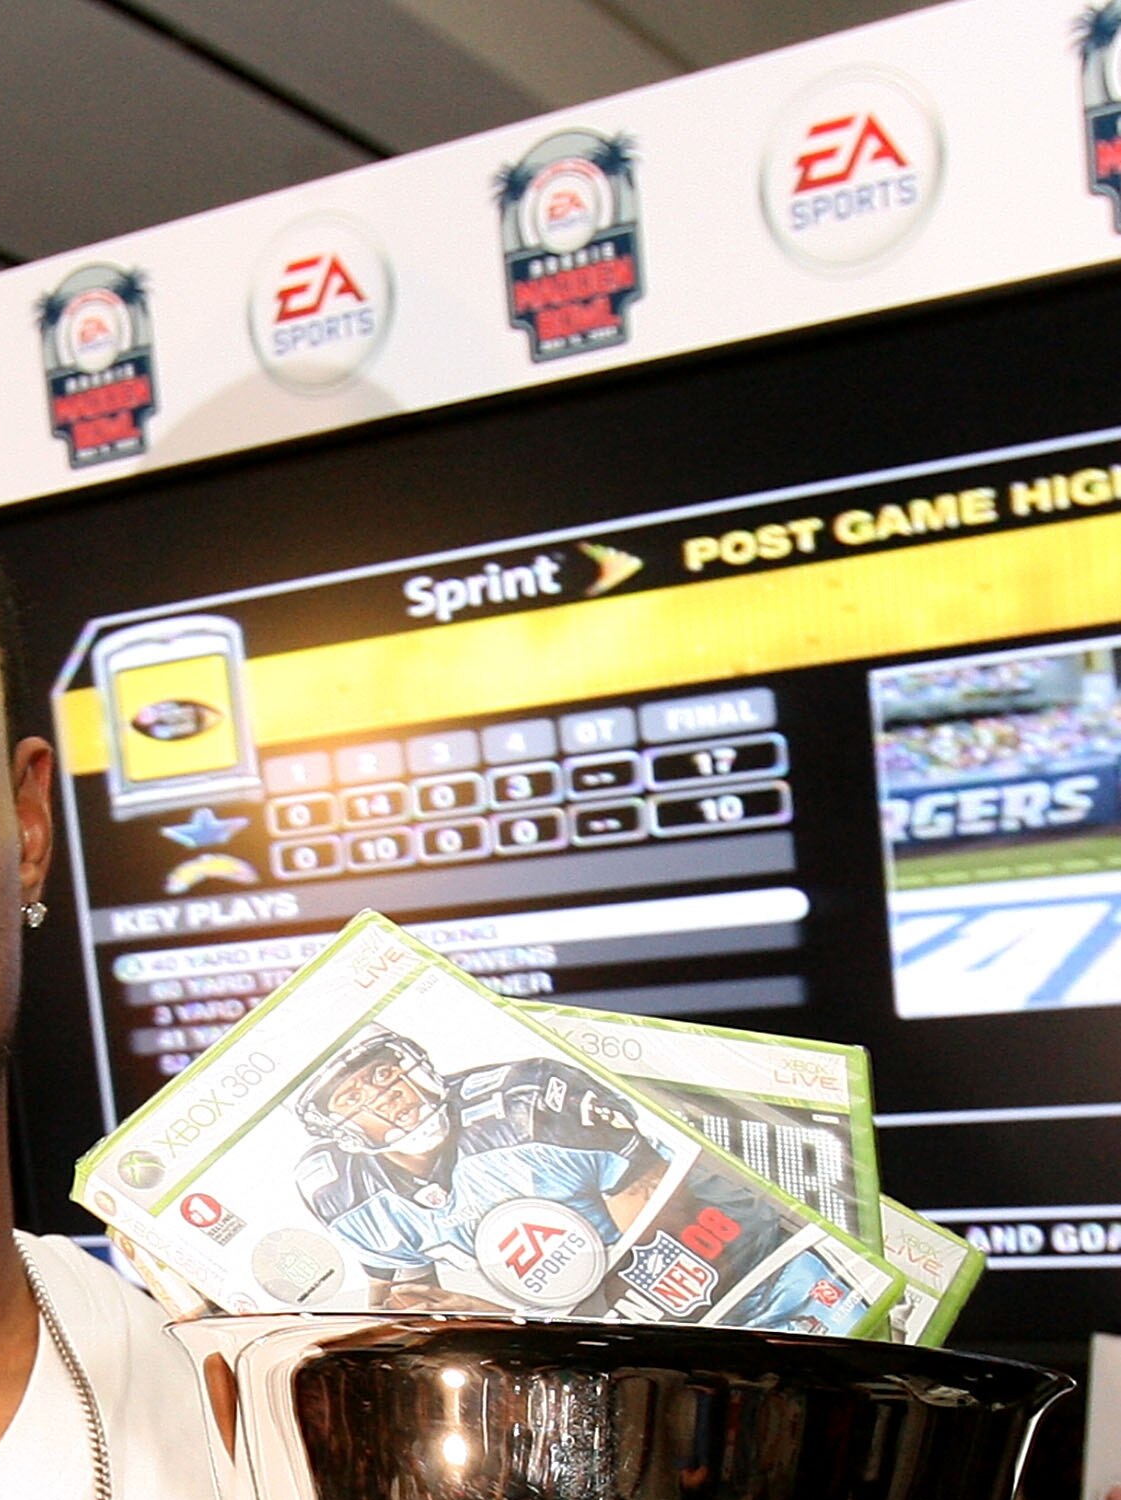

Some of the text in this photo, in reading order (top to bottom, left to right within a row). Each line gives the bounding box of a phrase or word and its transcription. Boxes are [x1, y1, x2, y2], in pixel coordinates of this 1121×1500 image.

[795, 113, 906, 194] EA
[791, 175, 917, 230] SPORTS
[275, 254, 367, 323] EA
[273, 307, 374, 355] SPORTS
[684, 518, 823, 571] POST
[833, 487, 999, 544] GAME
[403, 554, 562, 622] Sprint
[666, 699, 760, 732] FINAL
[287, 803, 312, 828] 0
[431, 784, 457, 810] 0
[693, 747, 738, 777] 17
[293, 846, 318, 871] 0
[360, 836, 399, 861] 10
[436, 827, 463, 853] 0
[512, 819, 539, 845] 0
[700, 794, 744, 823] 10
[112, 892, 300, 936] KEY PLAYS
[354, 946, 406, 988] LIVE
[580, 1032, 643, 1061] 360
[152, 1050, 277, 1158] XBOX 360
[773, 1069, 841, 1092] LIVE
[498, 1222, 567, 1279] EA
[523, 1232, 587, 1293] SPORTS
[653, 1206, 742, 1309] NFL 08
[966, 1222, 1045, 1254] AND
